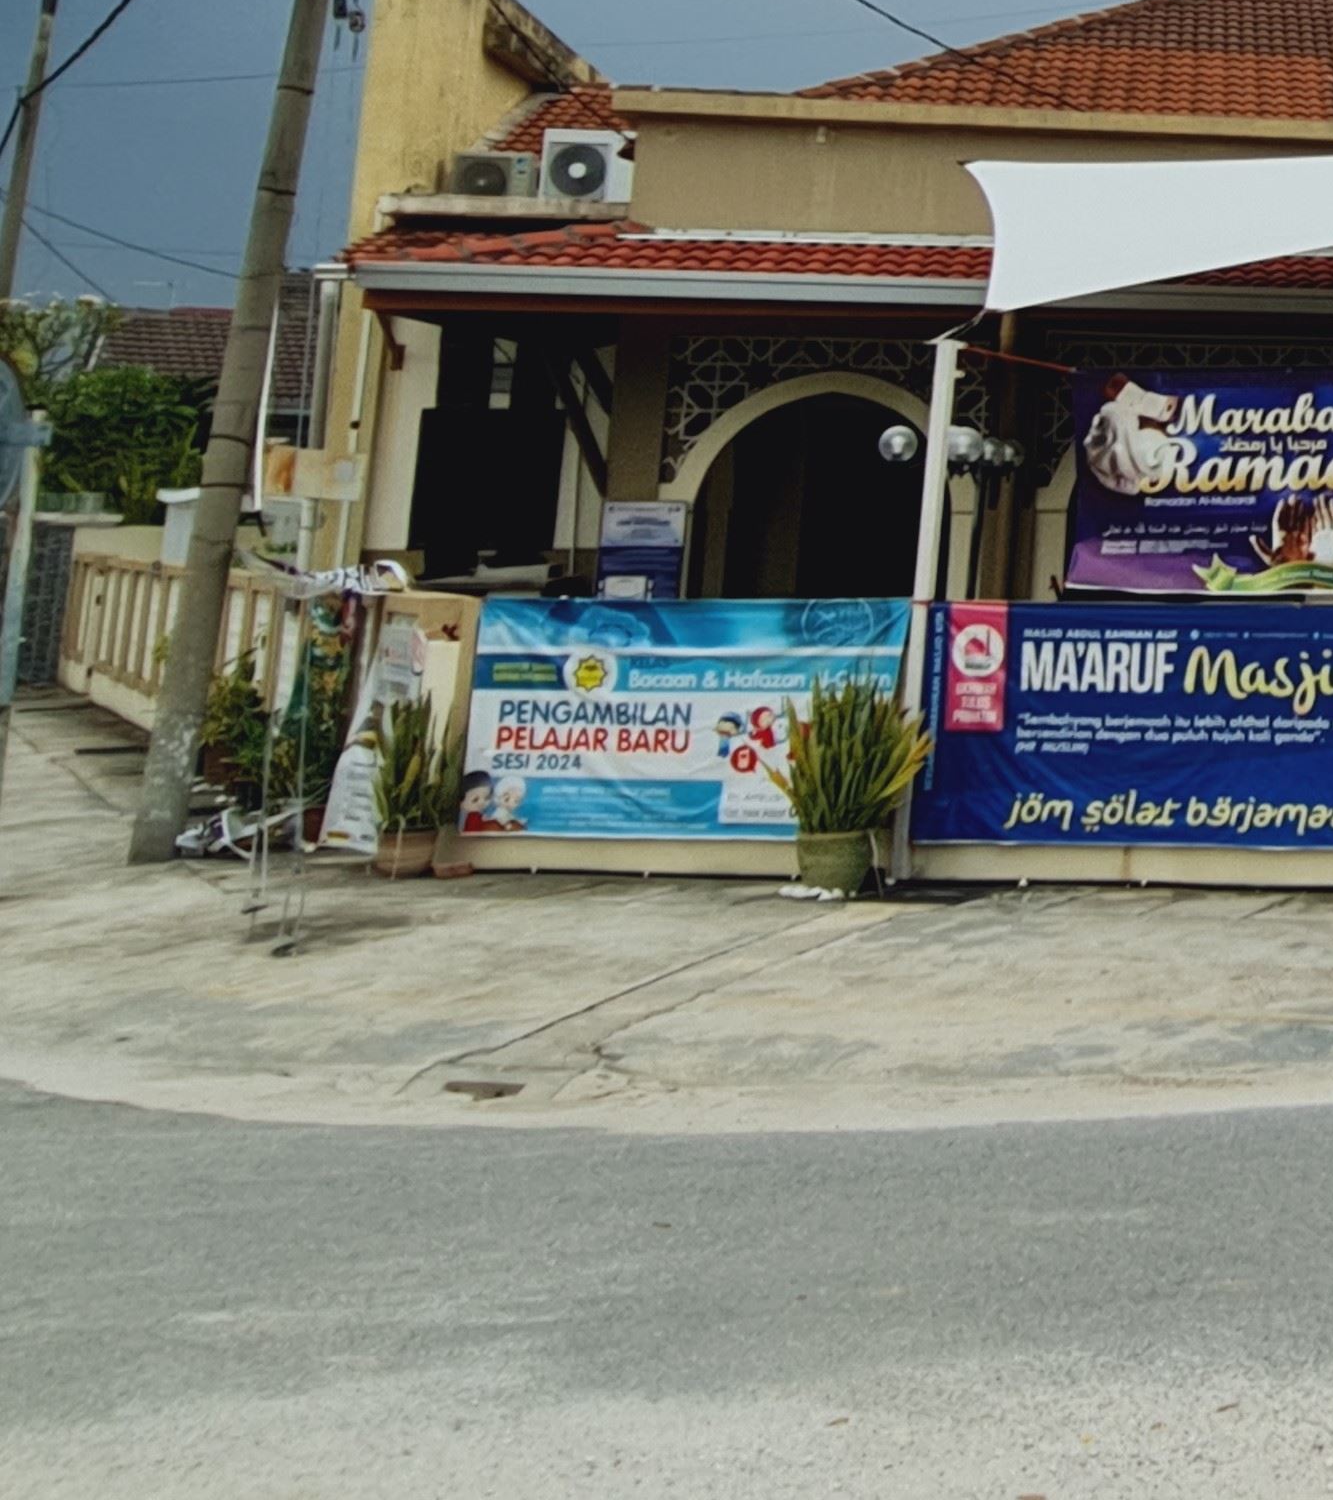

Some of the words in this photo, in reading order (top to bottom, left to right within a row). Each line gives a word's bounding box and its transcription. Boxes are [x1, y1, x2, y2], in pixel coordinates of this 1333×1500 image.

[628, 669, 696, 689] Bacaan
[702, 670, 719, 688] &
[1020, 640, 1178, 694] MA'ARUF
[499, 700, 692, 726] PENGAMBILAN
[496, 726, 608, 751] PELAJAR
[617, 728, 690, 753] BARU
[492, 754, 531, 770] SESI
[536, 754, 583, 771] 2024
